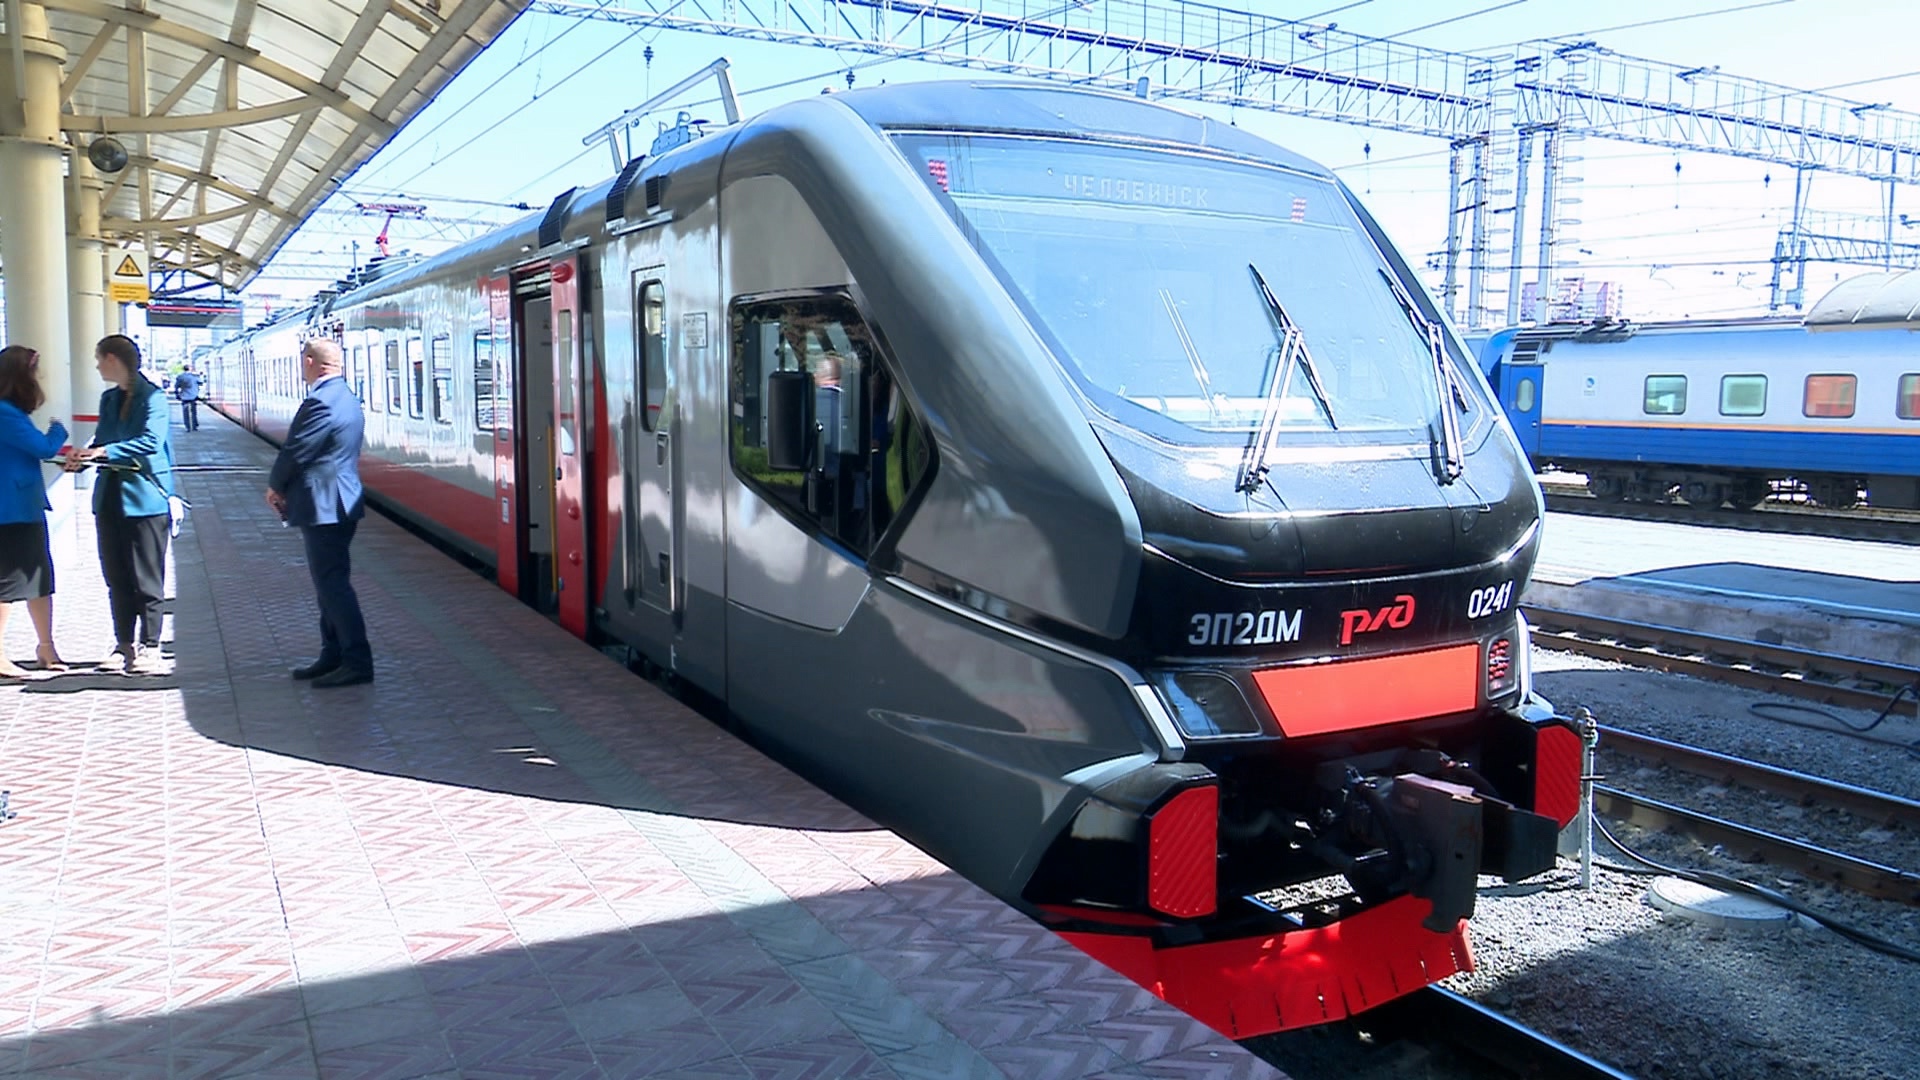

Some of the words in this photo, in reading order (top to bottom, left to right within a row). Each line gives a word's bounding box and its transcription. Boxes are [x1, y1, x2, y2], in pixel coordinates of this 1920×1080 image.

[1064, 174, 1208, 207] ЧЕЛЯБИНСК
[1467, 580, 1513, 619] 0241
[1188, 609, 1302, 645] ЭП2ДМ
